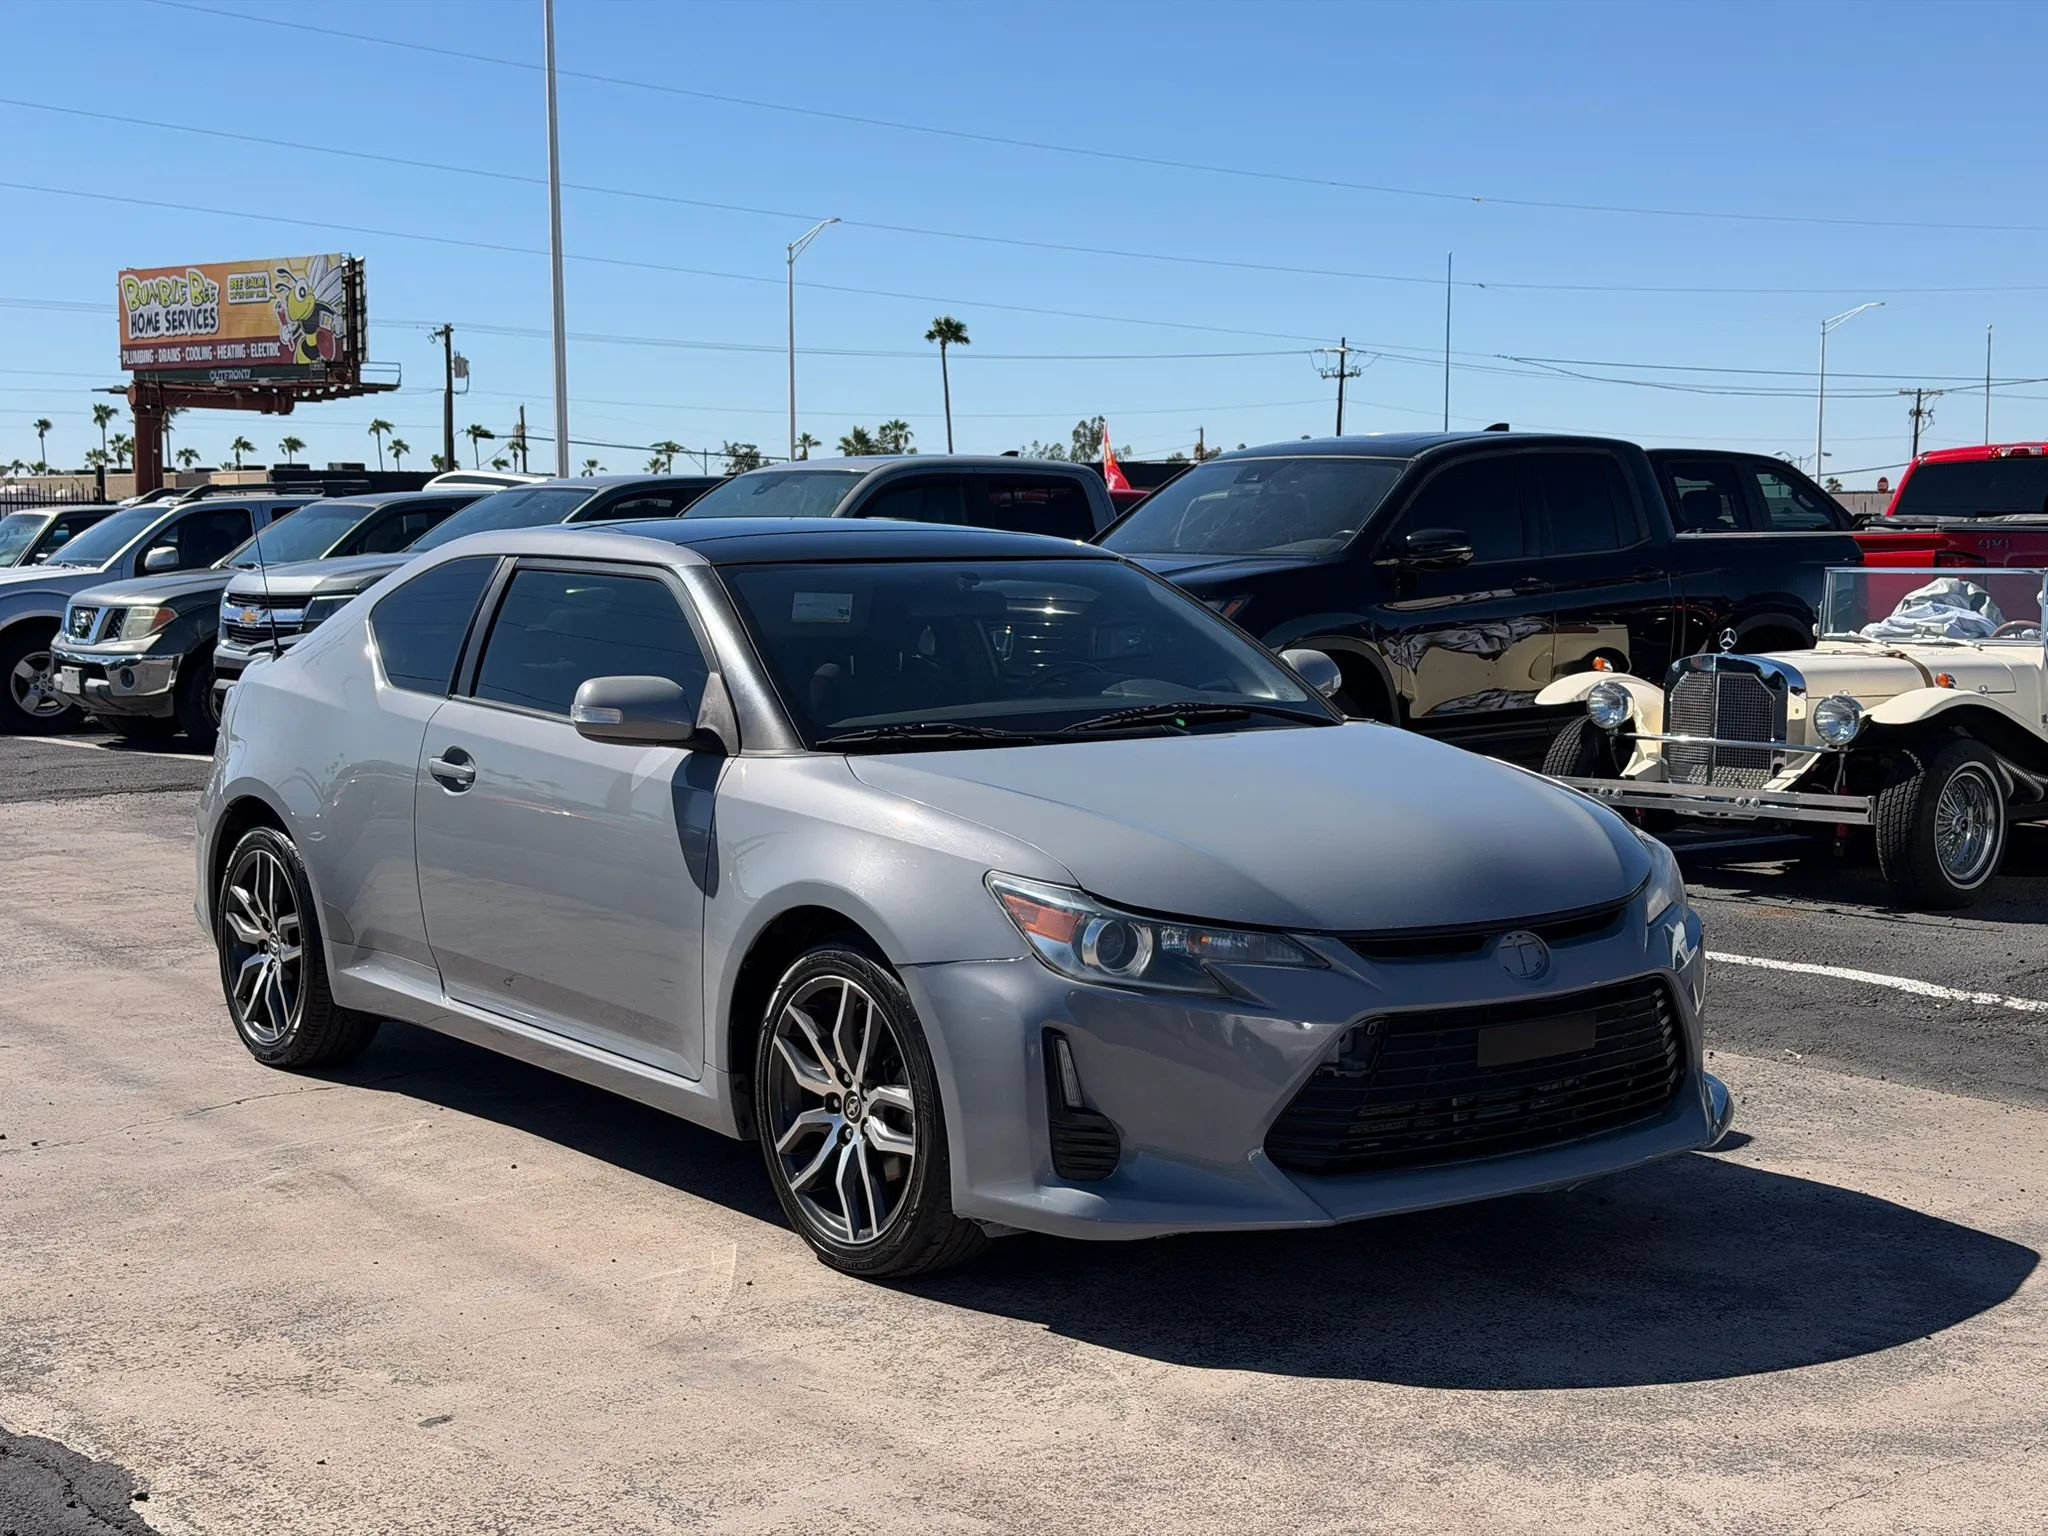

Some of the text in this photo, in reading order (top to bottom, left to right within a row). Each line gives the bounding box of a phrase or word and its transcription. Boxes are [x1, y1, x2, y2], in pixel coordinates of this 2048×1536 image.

[188, 271, 217, 306] BEE
[131, 306, 217, 335] HOME SERVICES
[123, 341, 281, 364] PLUMBING DRAINS COOLING HEATING ELECTRIC
